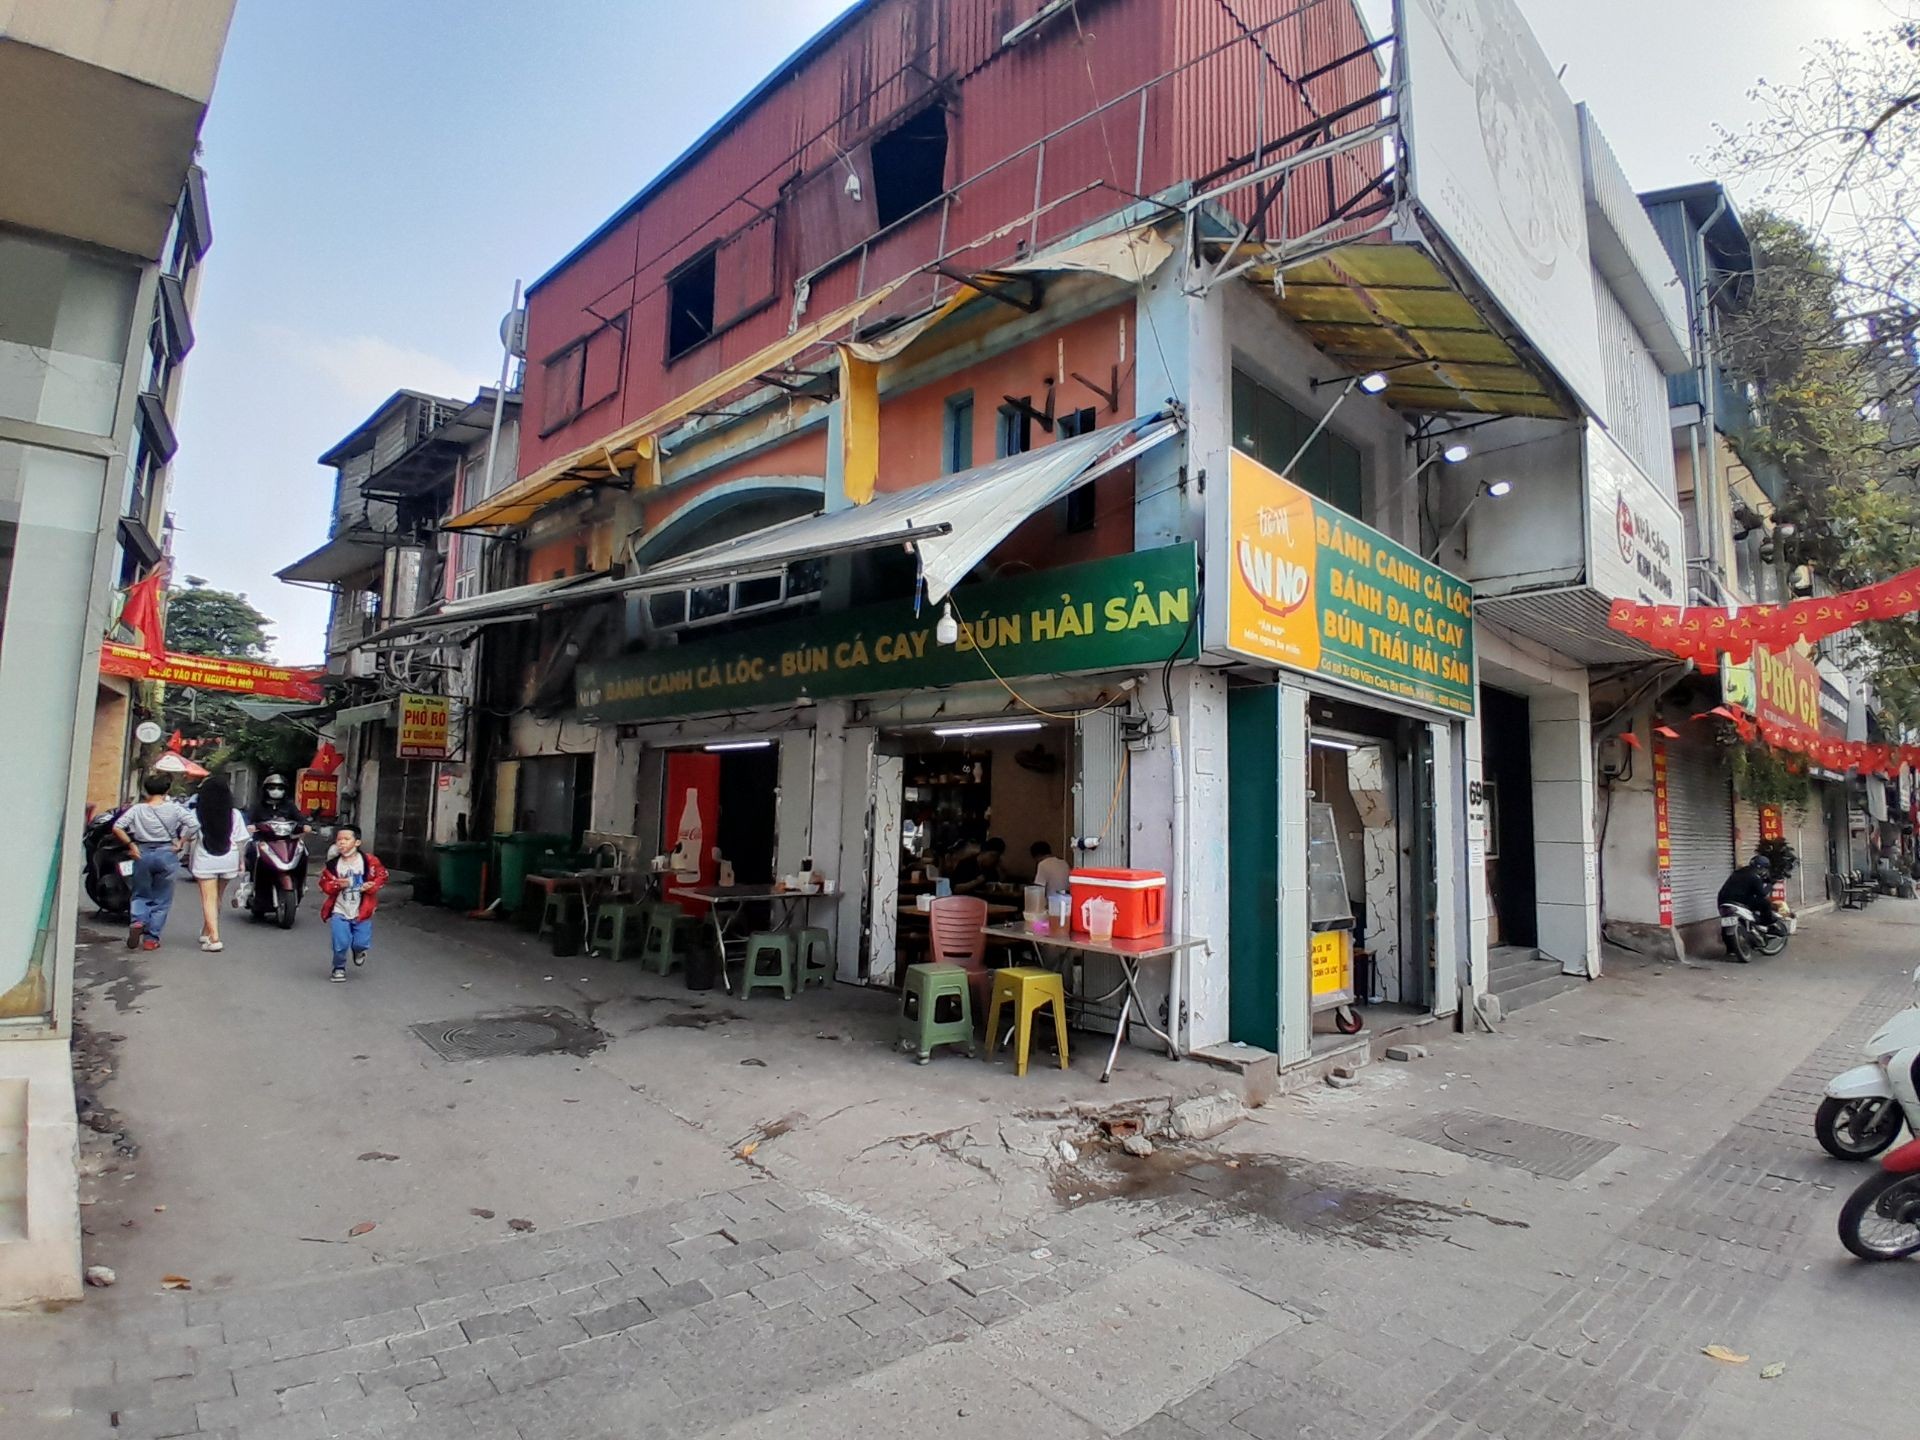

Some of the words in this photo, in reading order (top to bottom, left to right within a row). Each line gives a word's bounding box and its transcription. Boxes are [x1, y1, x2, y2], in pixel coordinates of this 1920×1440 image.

[1276, 557, 1307, 604] NO
[1316, 515, 1371, 569] BÁNH
[1375, 549, 1421, 594] CANH
[1424, 574, 1443, 604] CÁ
[1446, 586, 1472, 618] LÓC
[649, 669, 692, 696] CANH
[698, 658, 721, 689] CÁ
[725, 654, 764, 685] LÓC
[781, 642, 828, 677] BÚN
[834, 633, 869, 669] CÁ
[875, 629, 929, 663] CAY
[955, 611, 1021, 652] BÚN
[1031, 593, 1094, 642] HẢI
[1104, 581, 1188, 632] SẢN
[1323, 608, 1364, 649] BÚN
[1368, 630, 1408, 665] THÁI
[1412, 640, 1439, 675] HẢI
[1442, 650, 1469, 686] SẢN
[1330, 567, 1382, 616] BÁNH
[1386, 594, 1410, 629] ĐA
[1414, 606, 1435, 638] CÁ
[1436, 618, 1463, 649] CAY
[1799, 674, 1818, 731] GÀ
[1469, 781, 1482, 806] 69
